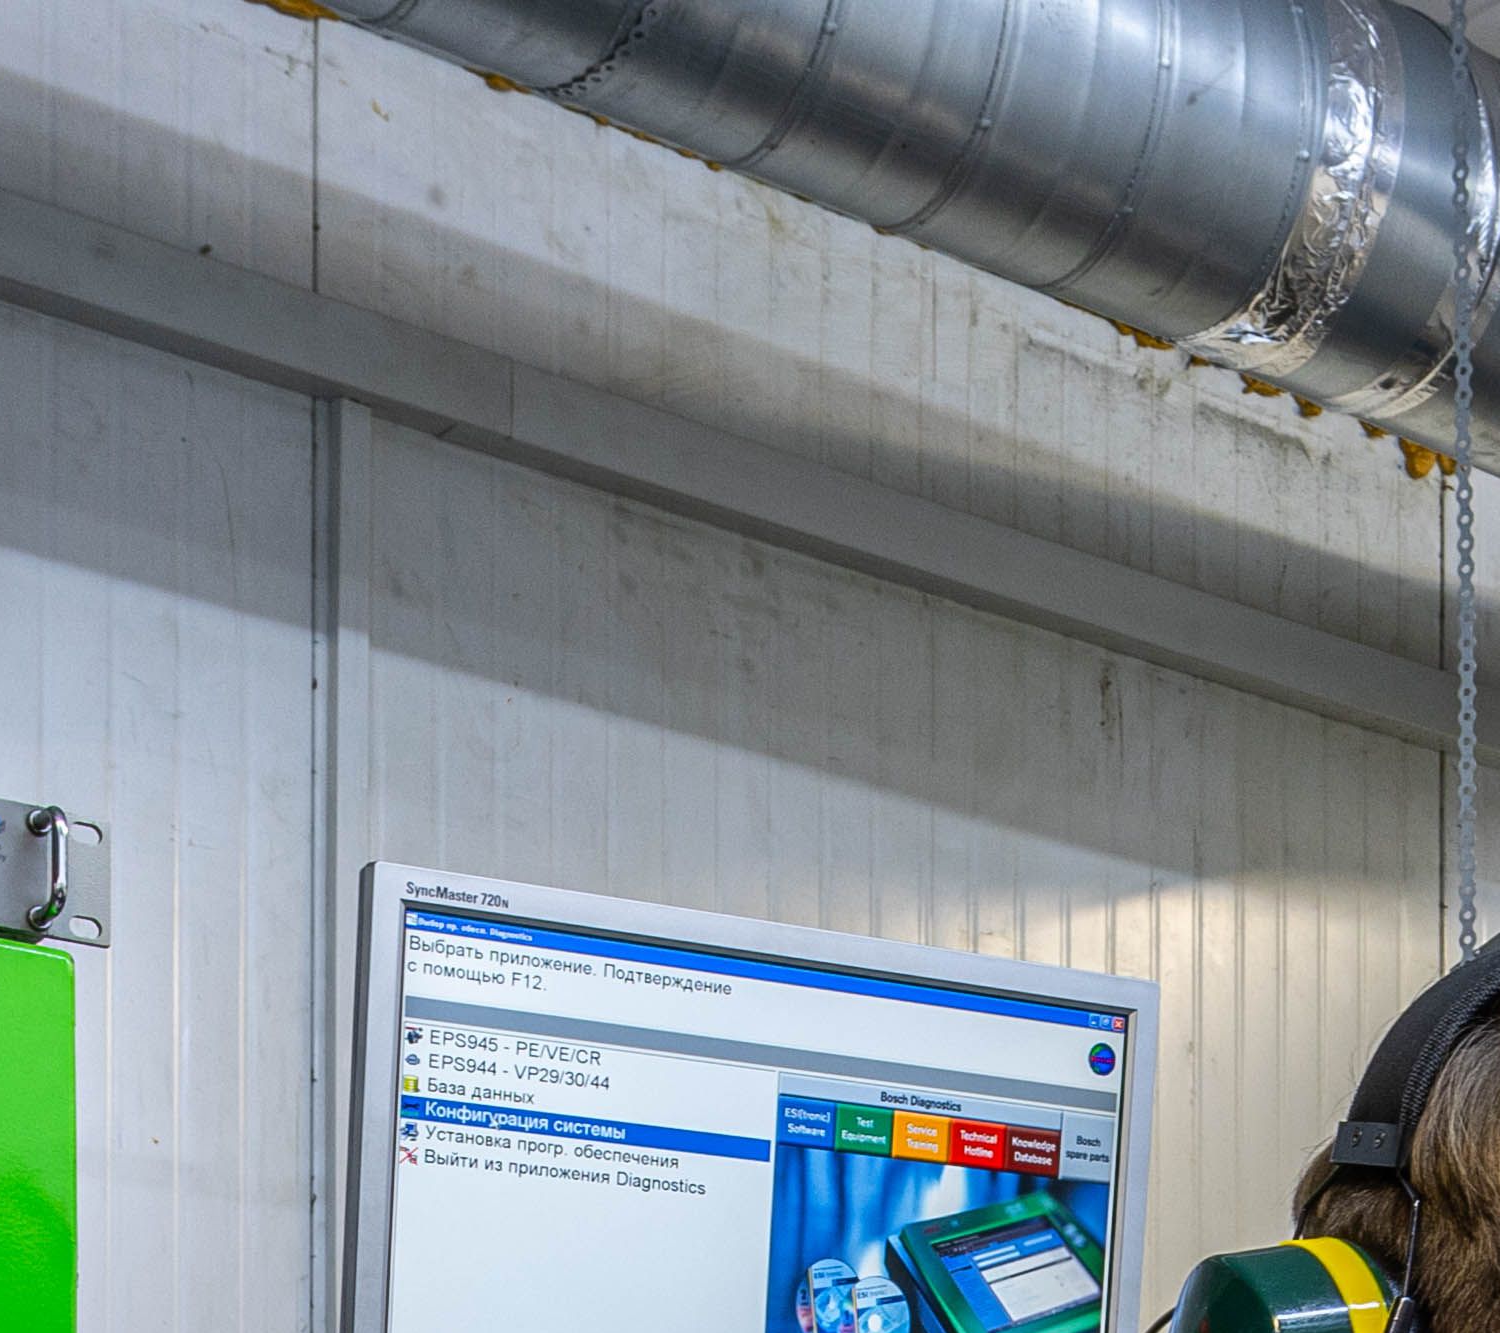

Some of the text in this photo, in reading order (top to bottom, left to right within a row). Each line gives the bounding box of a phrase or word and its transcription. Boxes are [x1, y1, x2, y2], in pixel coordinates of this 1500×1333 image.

[406, 880, 479, 905] SyncMaster
[407, 961, 548, 992] с помощью F12.
[409, 935, 733, 996] Выбрать приложение. Подтверждение
[429, 1029, 602, 1066] EPS945 PE/VE/CR
[428, 1053, 611, 1090] EPS944 VP29/30/44
[427, 1077, 535, 1105] База данных
[880, 1091, 962, 1113] Bosch Diagnostics
[425, 1101, 626, 1140] Конфигурация системы
[856, 1116, 875, 1129] Test
[426, 1125, 679, 1169] Установка прогр. обеспечения
[841, 1129, 888, 1146] Equipment
[959, 1129, 998, 1145] Technical
[1011, 1136, 1057, 1153] Knowledge
[1076, 1135, 1101, 1148] Bosch
[964, 1144, 994, 1160] Hotline
[1014, 1151, 1053, 1167] Database
[1089, 1152, 1110, 1164] parts
[424, 1149, 706, 1196] Выйти из приложения Diagnostics
